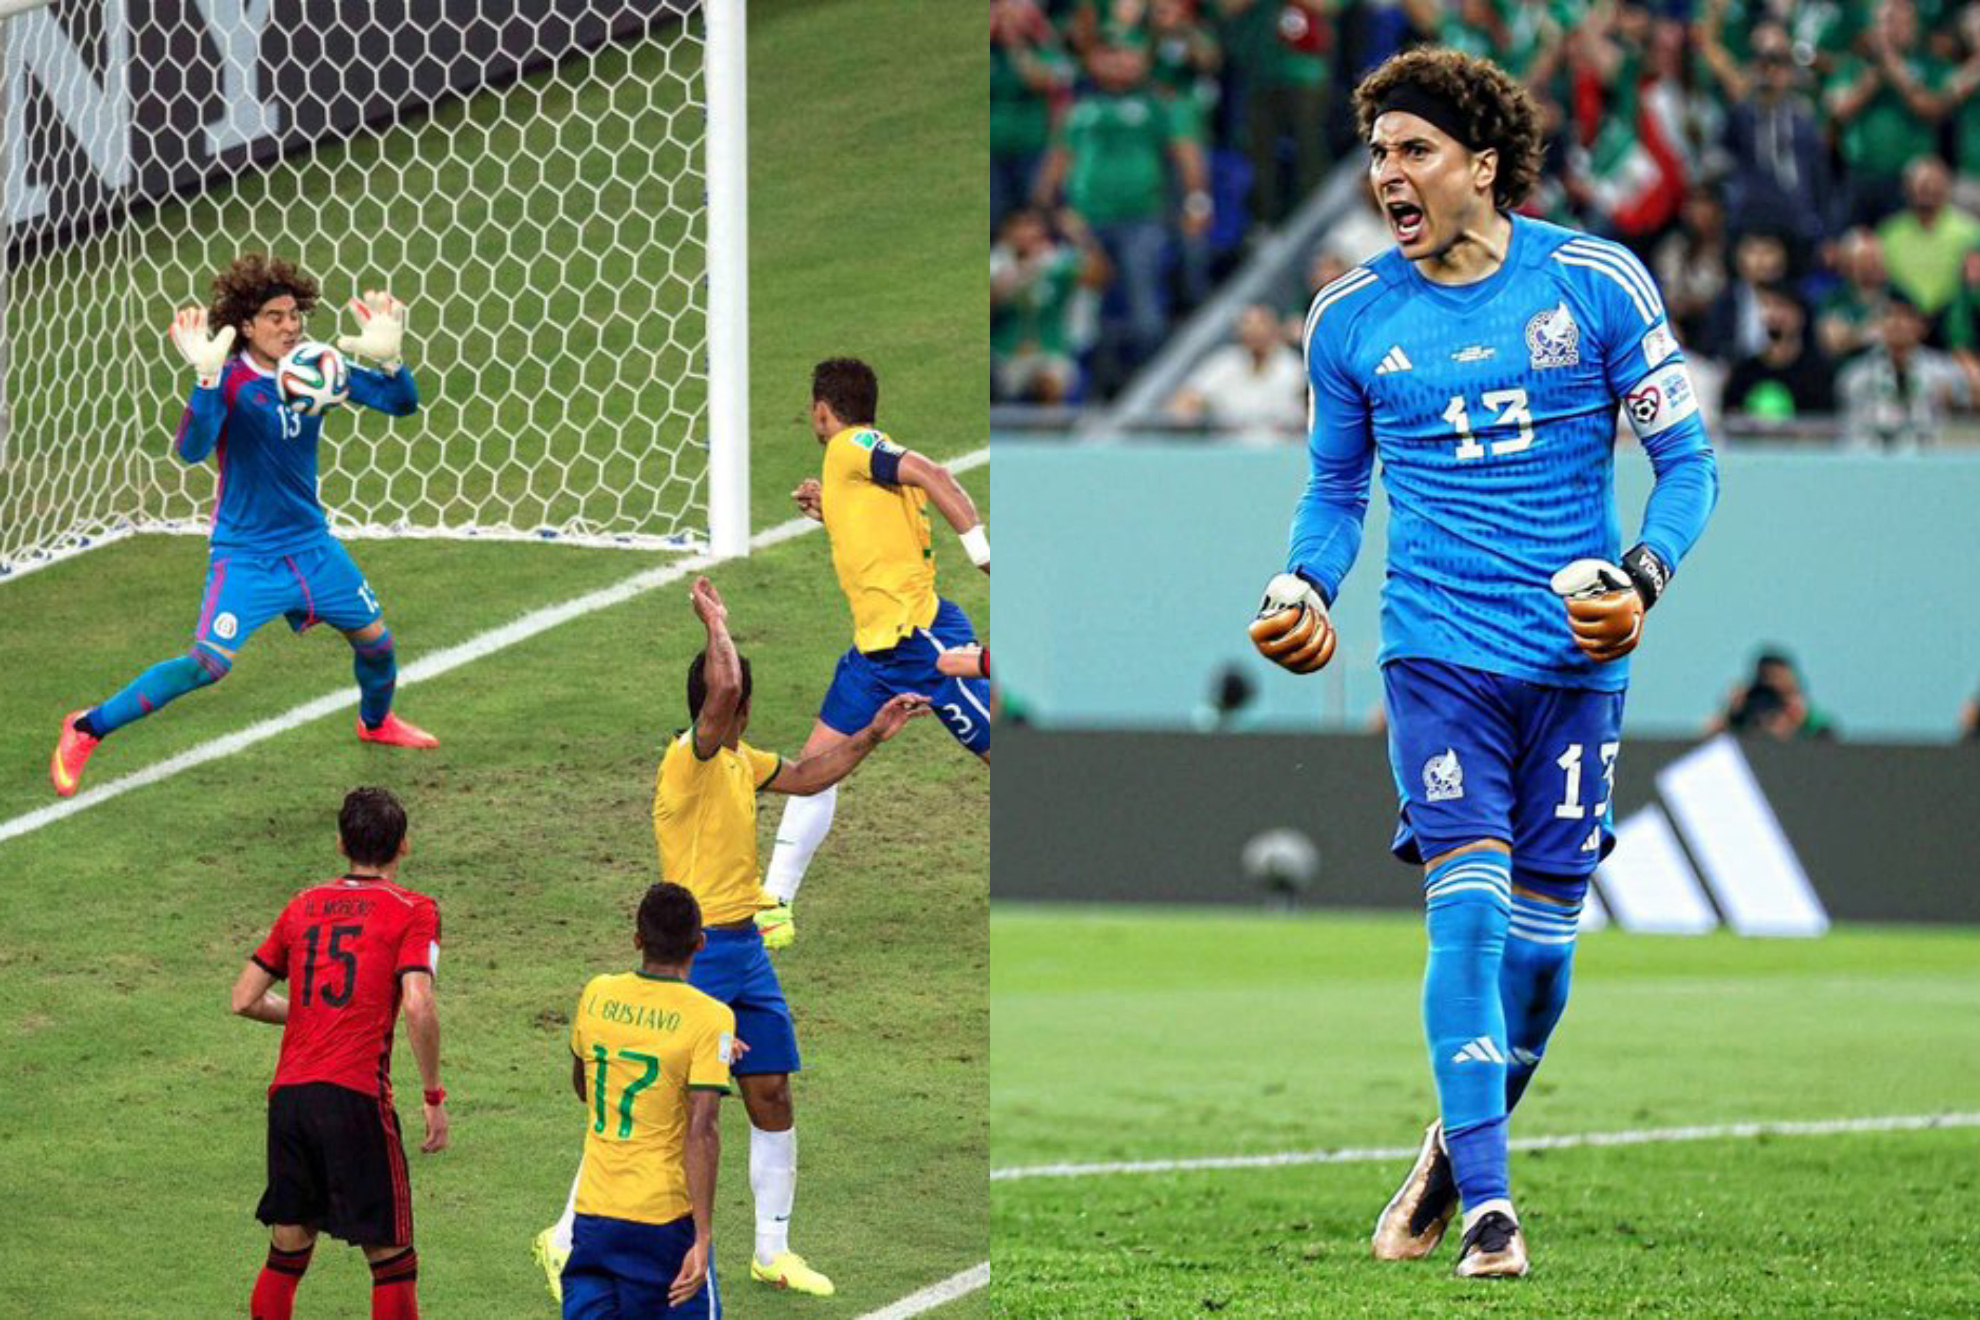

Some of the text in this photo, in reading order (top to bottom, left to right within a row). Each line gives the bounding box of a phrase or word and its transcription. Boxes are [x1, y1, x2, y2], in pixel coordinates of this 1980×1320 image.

[276, 403, 301, 440] 13
[1442, 388, 1536, 460] 13
[943, 703, 973, 735] 3
[301, 924, 363, 1009] 15
[602, 999, 682, 1034] GUSTAVO
[592, 1043, 659, 1139] 17
